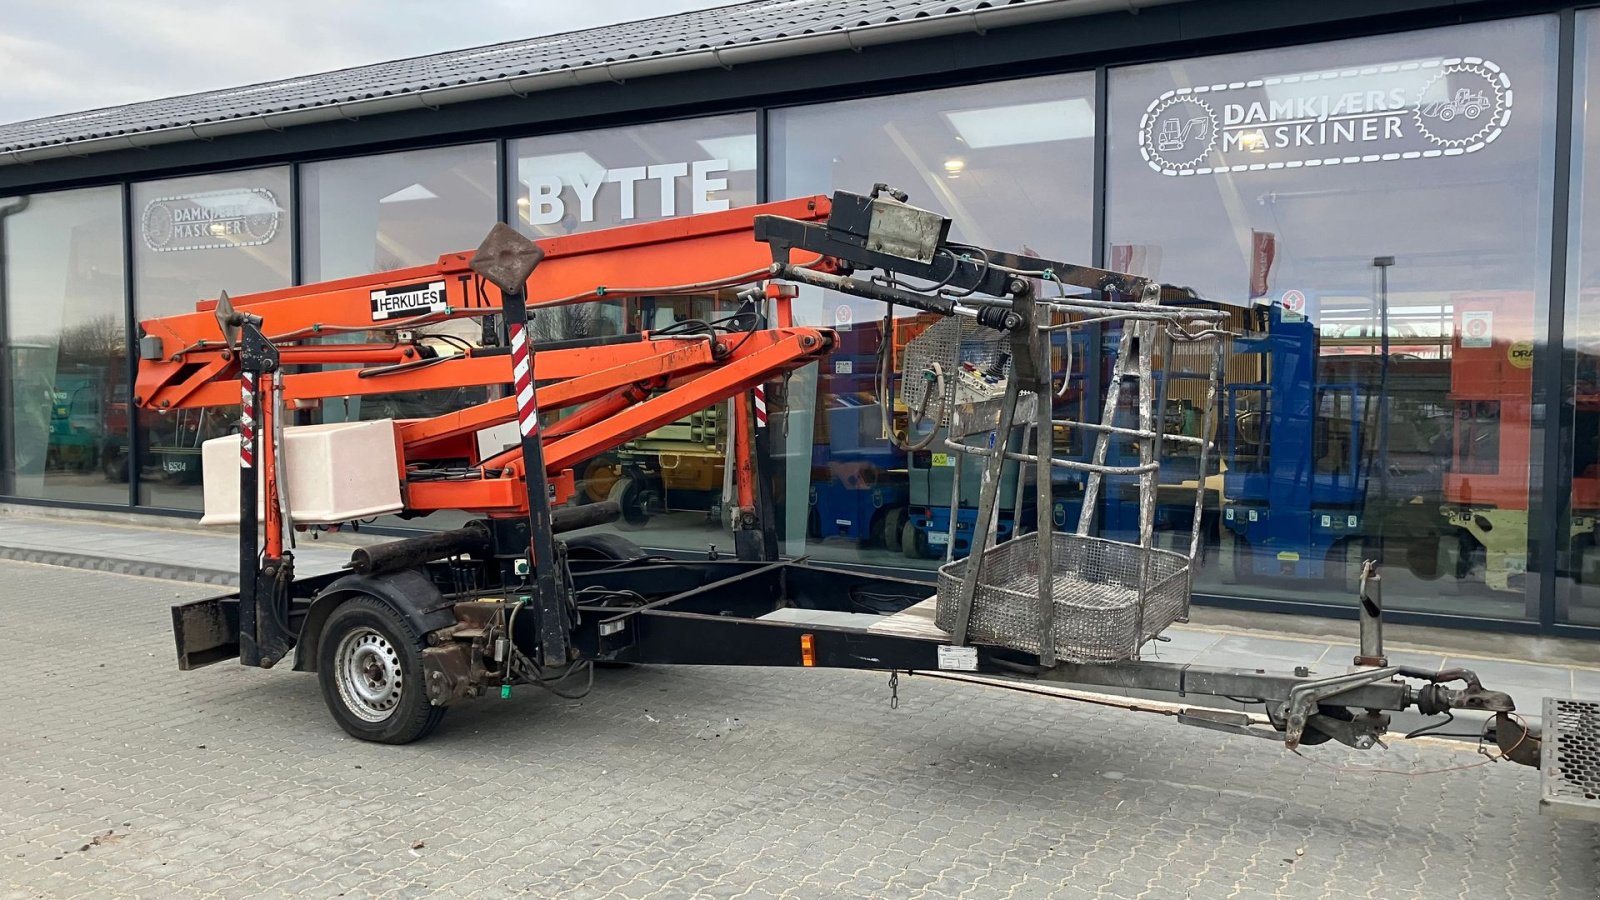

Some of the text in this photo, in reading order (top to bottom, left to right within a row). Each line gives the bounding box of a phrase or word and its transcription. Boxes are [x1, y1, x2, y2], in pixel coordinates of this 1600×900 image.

[1223, 88, 1407, 125] DAMKJÆRS
[1223, 116, 1403, 153] MASKINER
[527, 158, 730, 226] BYTTE
[173, 220, 242, 239] MASKER
[379, 291, 438, 311] HERKULES
[457, 273, 492, 308] TK
